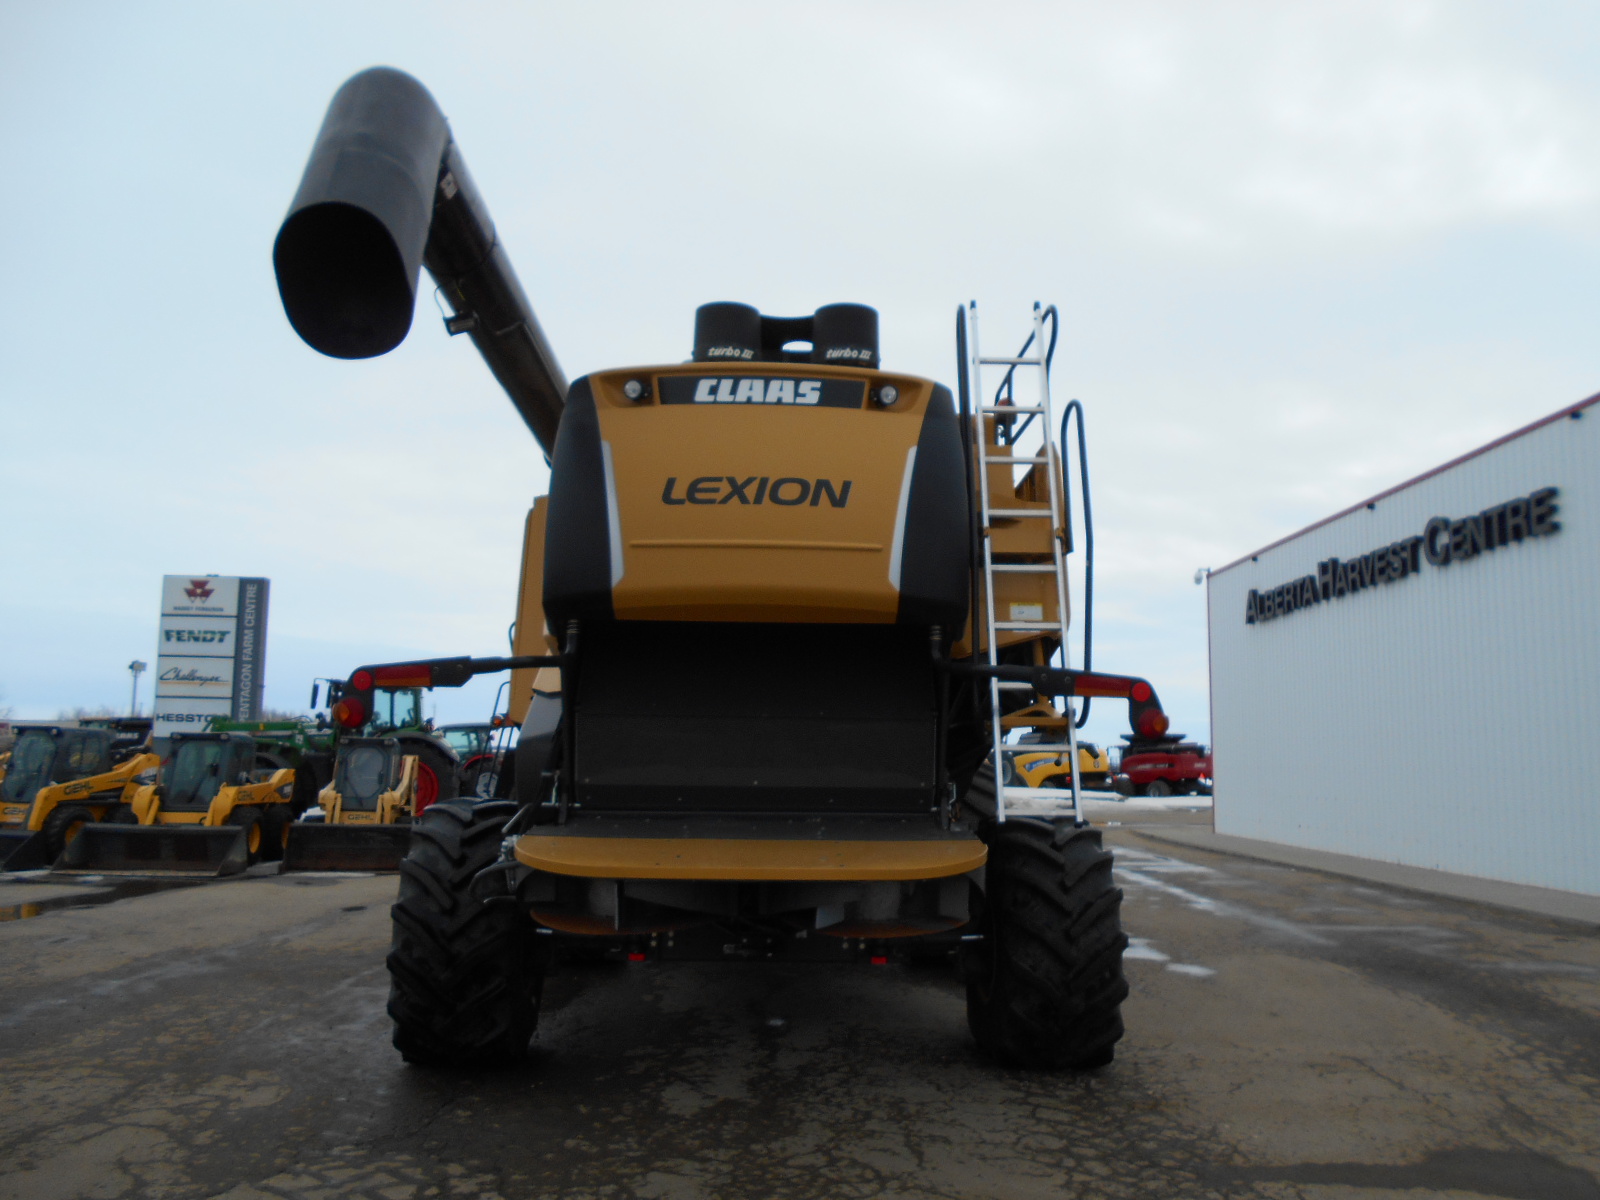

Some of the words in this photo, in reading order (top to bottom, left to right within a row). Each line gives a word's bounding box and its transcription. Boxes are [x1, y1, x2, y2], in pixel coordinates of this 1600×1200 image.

[708, 346, 741, 358] turbo
[826, 347, 859, 359] turbo
[694, 378, 822, 405] CLAAS
[661, 476, 852, 508] LEXION
[1246, 574, 1321, 625] ALBERTA
[1317, 534, 1425, 602] HARVEST
[1423, 486, 1563, 567] CENTRE
[245, 583, 258, 627] CENTRE
[164, 629, 231, 643] FENDT
[243, 630, 255, 661] FARM
[156, 713, 214, 723] HESSTO
